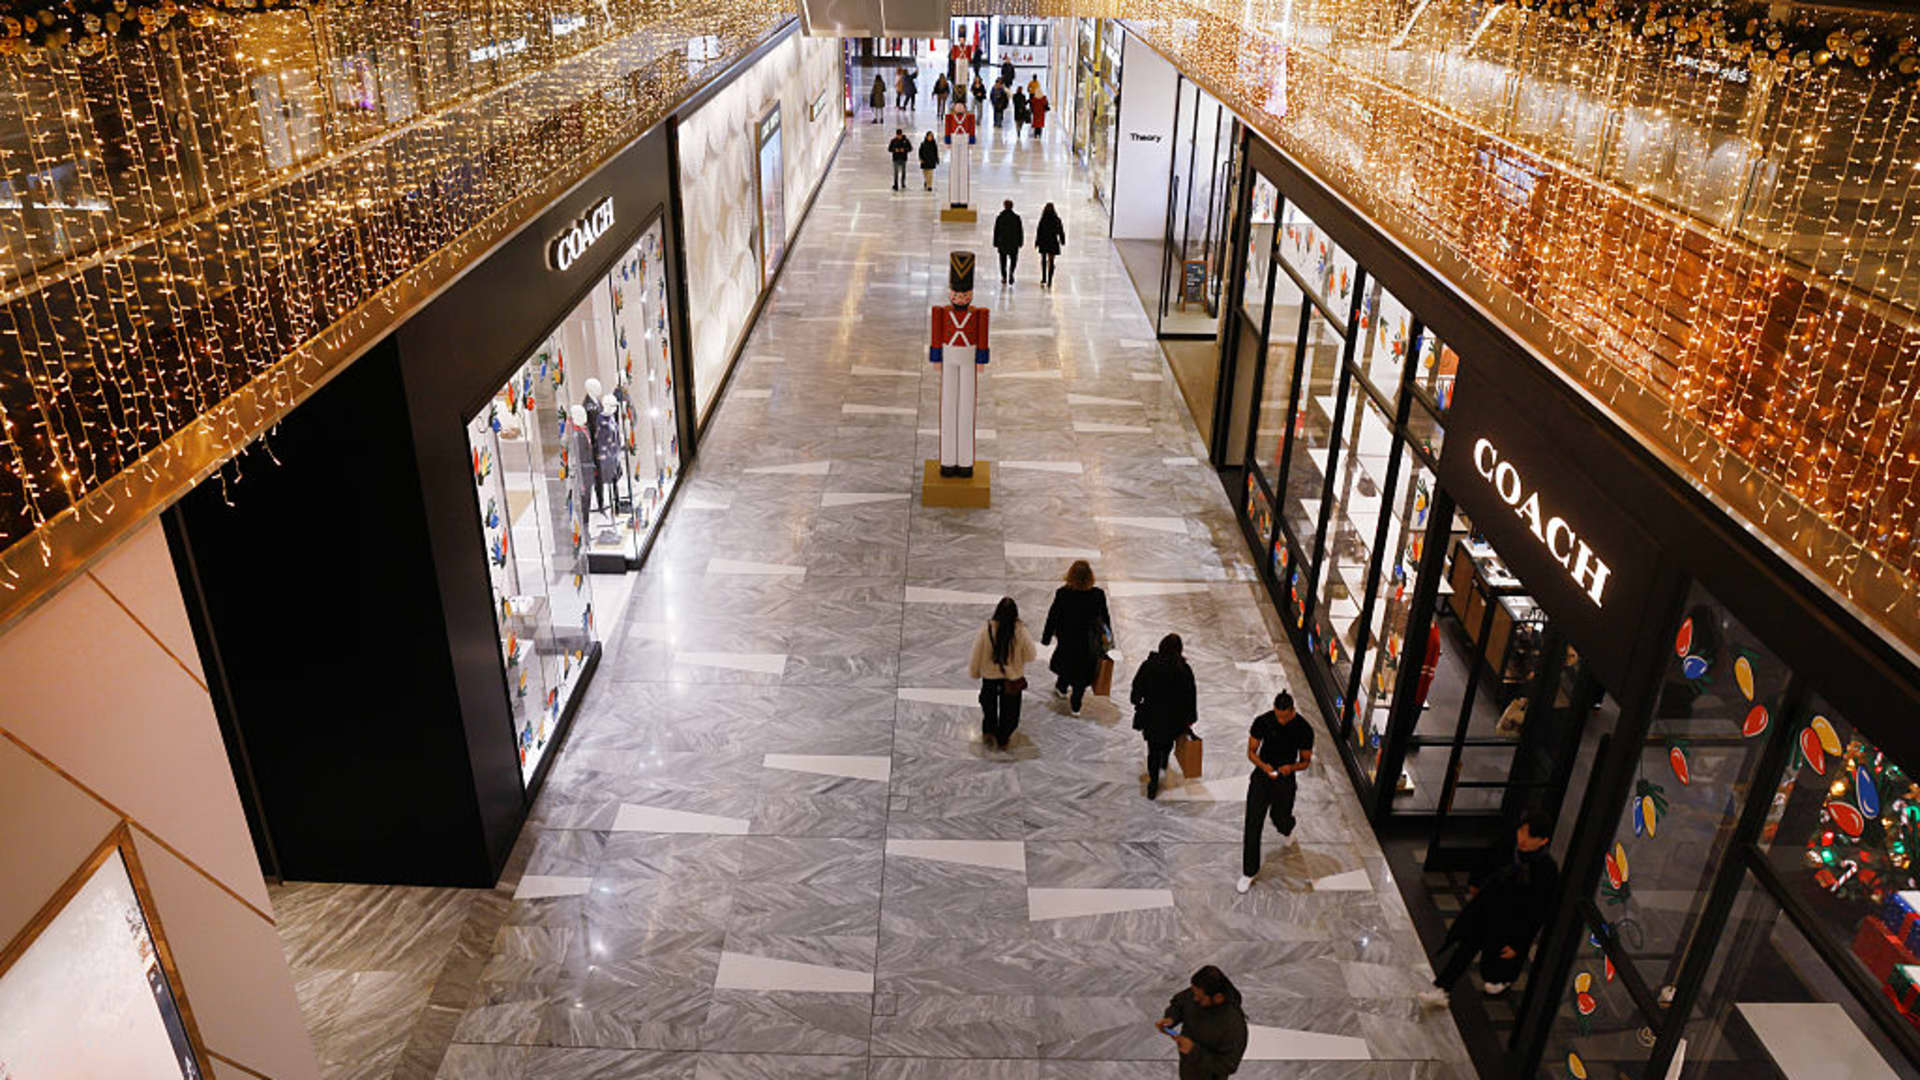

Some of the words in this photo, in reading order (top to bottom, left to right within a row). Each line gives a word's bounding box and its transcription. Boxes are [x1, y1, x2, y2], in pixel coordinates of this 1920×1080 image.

[1129, 132, 1162, 144] Theory
[557, 196, 615, 271] COACH
[1473, 437, 1612, 609] COACH
